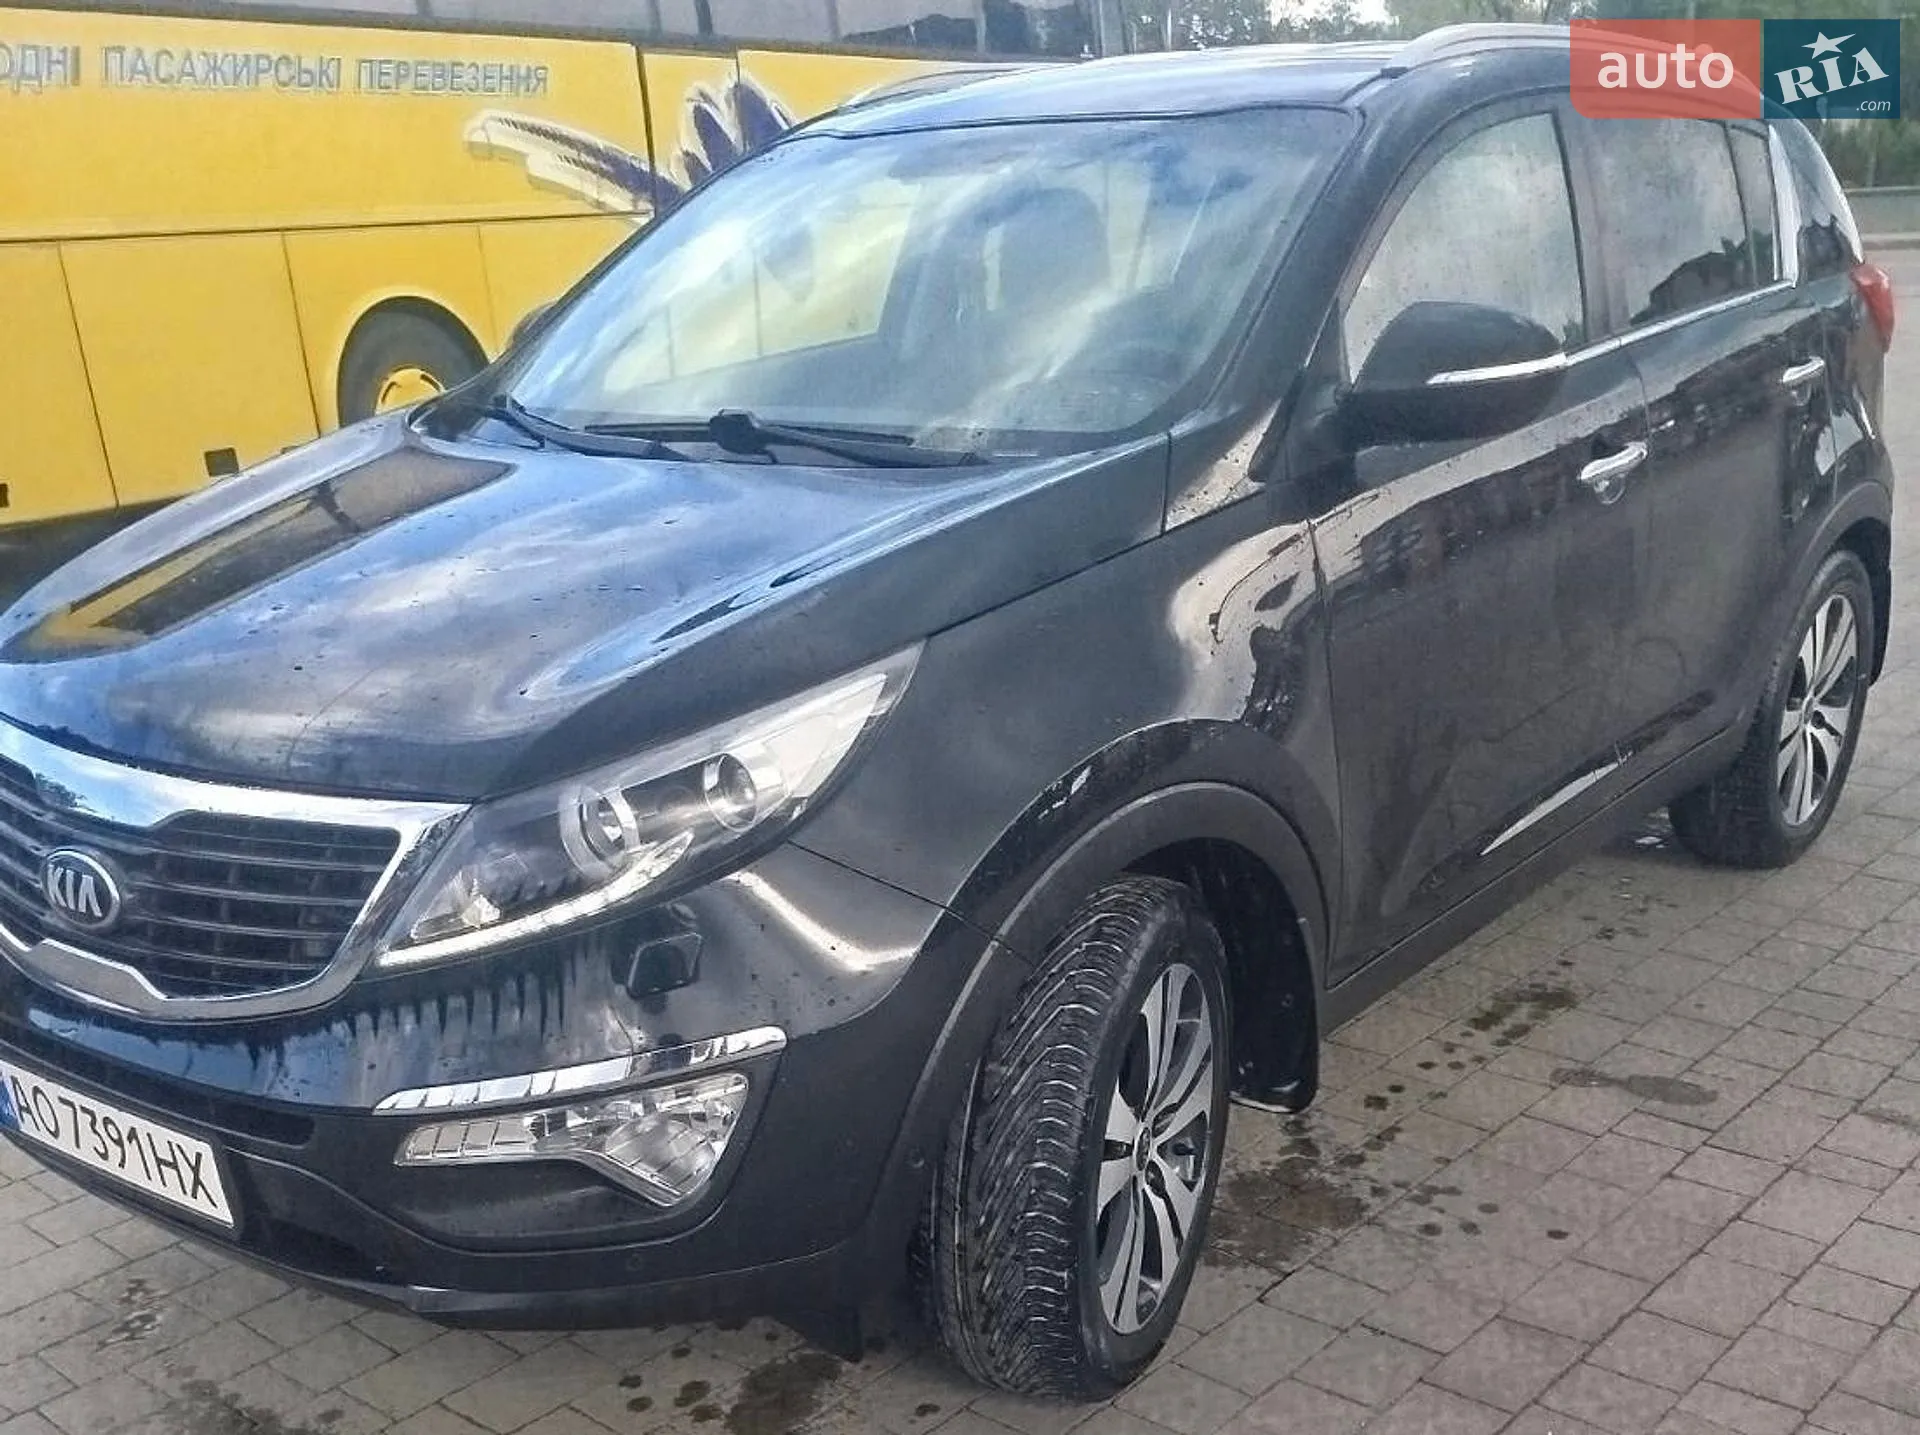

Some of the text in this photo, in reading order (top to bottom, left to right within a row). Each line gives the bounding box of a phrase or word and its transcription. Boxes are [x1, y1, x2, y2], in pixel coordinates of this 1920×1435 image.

[102, 45, 342, 91] ПАСАЖИРСЬКІ
[357, 58, 549, 96] ПЕРЕВЕЗЕННЯ
[47, 864, 103, 917] KIA
